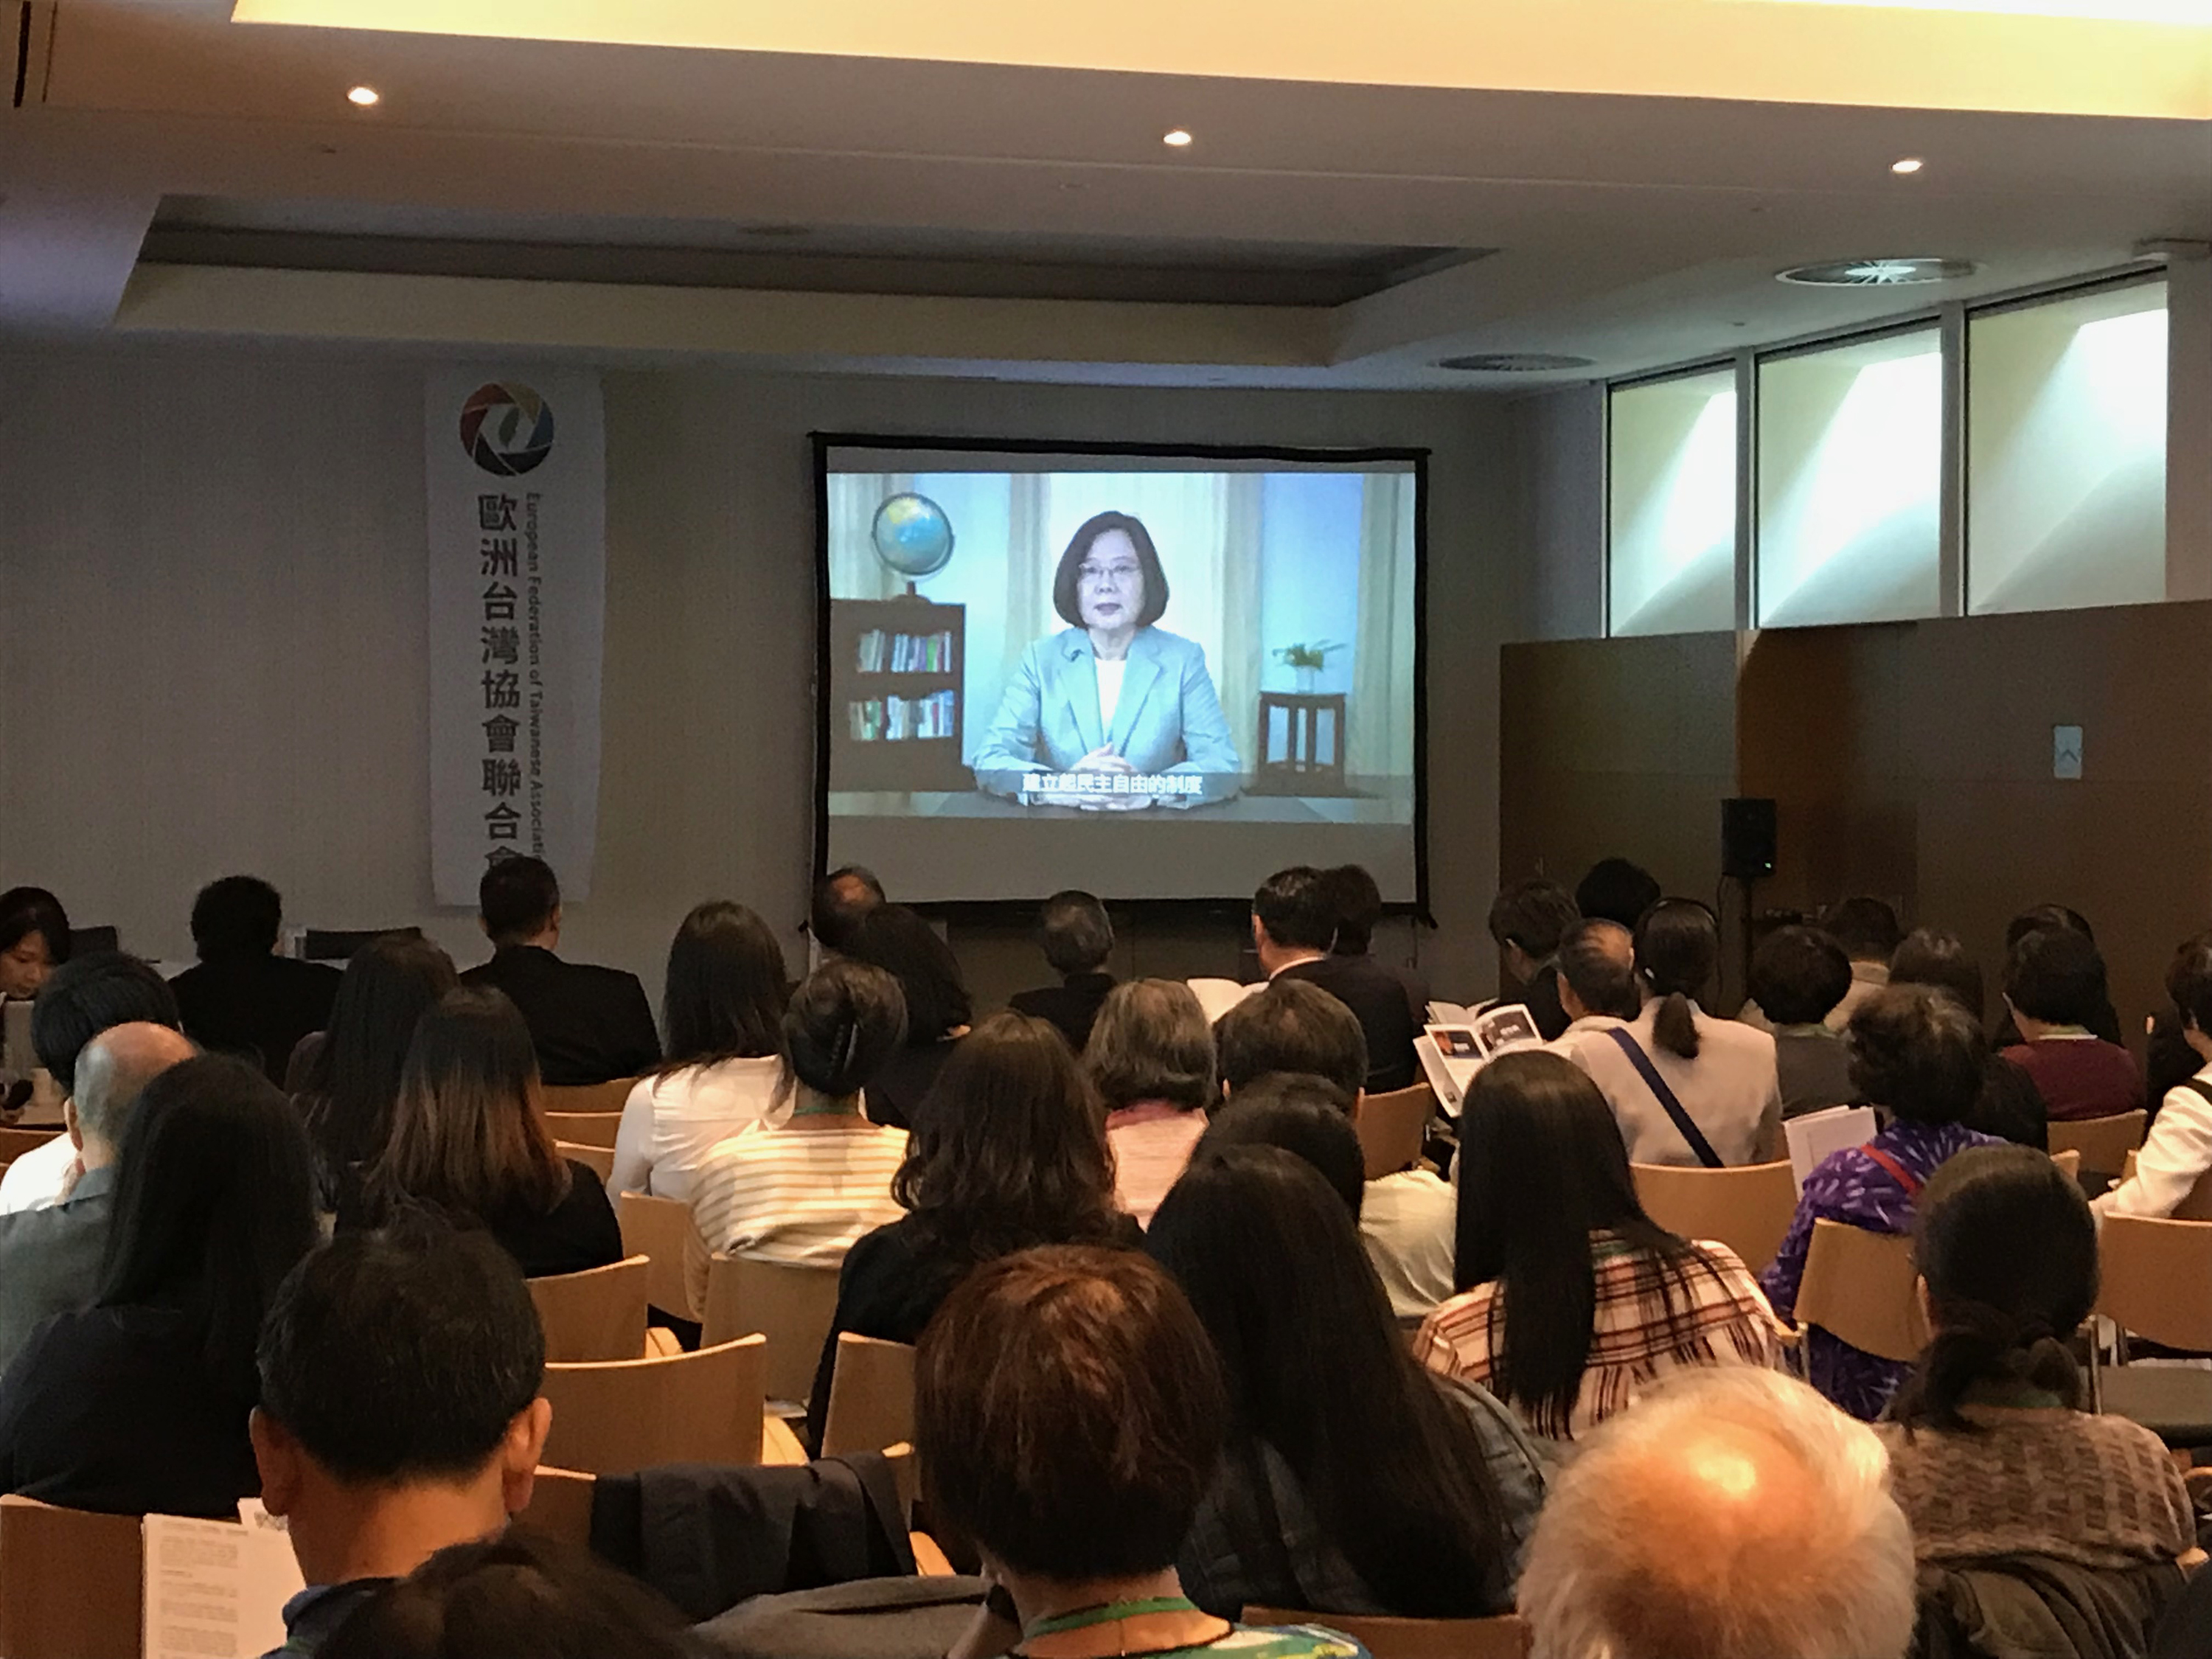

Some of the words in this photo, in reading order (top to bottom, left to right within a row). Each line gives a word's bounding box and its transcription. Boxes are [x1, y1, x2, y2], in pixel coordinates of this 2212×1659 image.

[524, 493, 543, 571] European
[527, 576, 543, 665] Federation
[529, 669, 543, 686] of
[529, 692, 543, 776] Taiwanese
[1022, 773, 1203, 795] 建立起民主自由的制度
